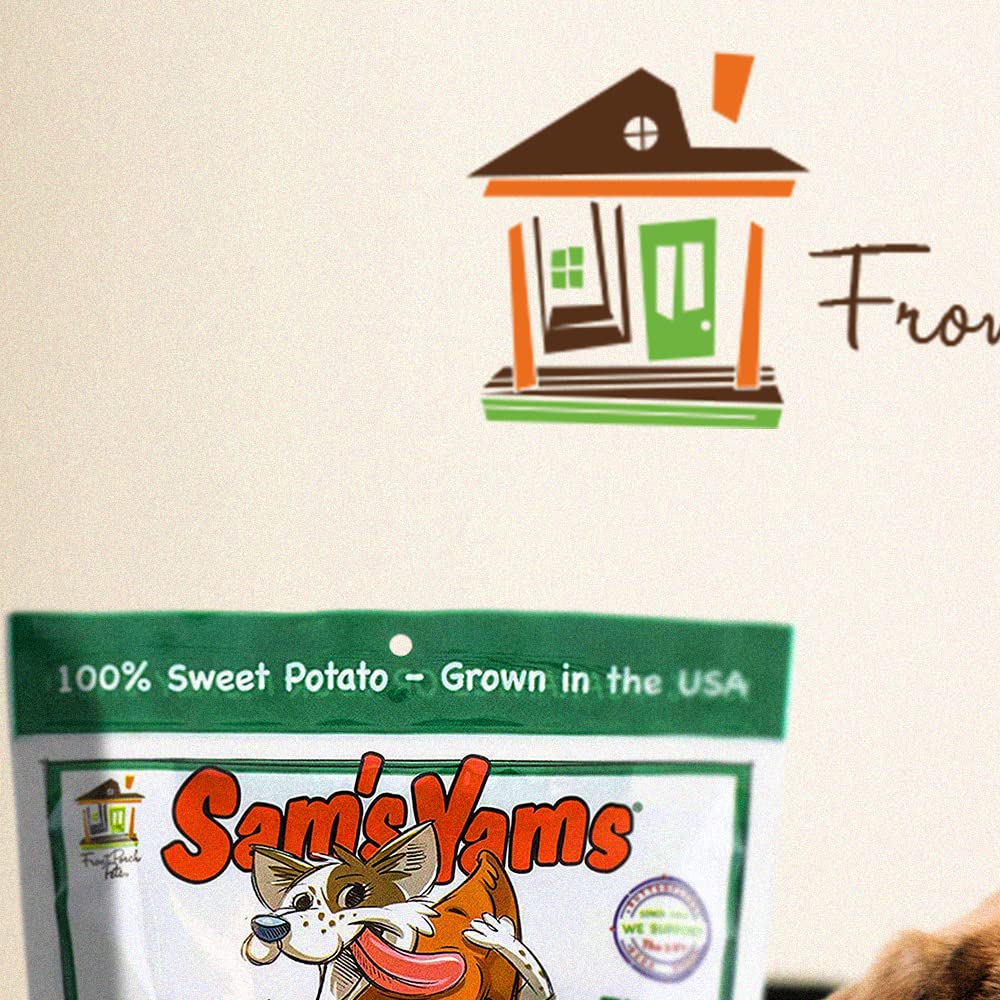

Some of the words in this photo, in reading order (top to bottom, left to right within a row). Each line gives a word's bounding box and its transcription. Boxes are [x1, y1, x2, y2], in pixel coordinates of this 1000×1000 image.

[58, 660, 152, 694] 100%
[167, 662, 271, 693] Sweet
[284, 660, 389, 693] Potato
[441, 661, 546, 693] Grown
[562, 662, 590, 694] in
[606, 664, 663, 696] the
[677, 668, 749, 699] USA
[161, 751, 408, 884] Sam's
[411, 754, 634, 885] Yams
